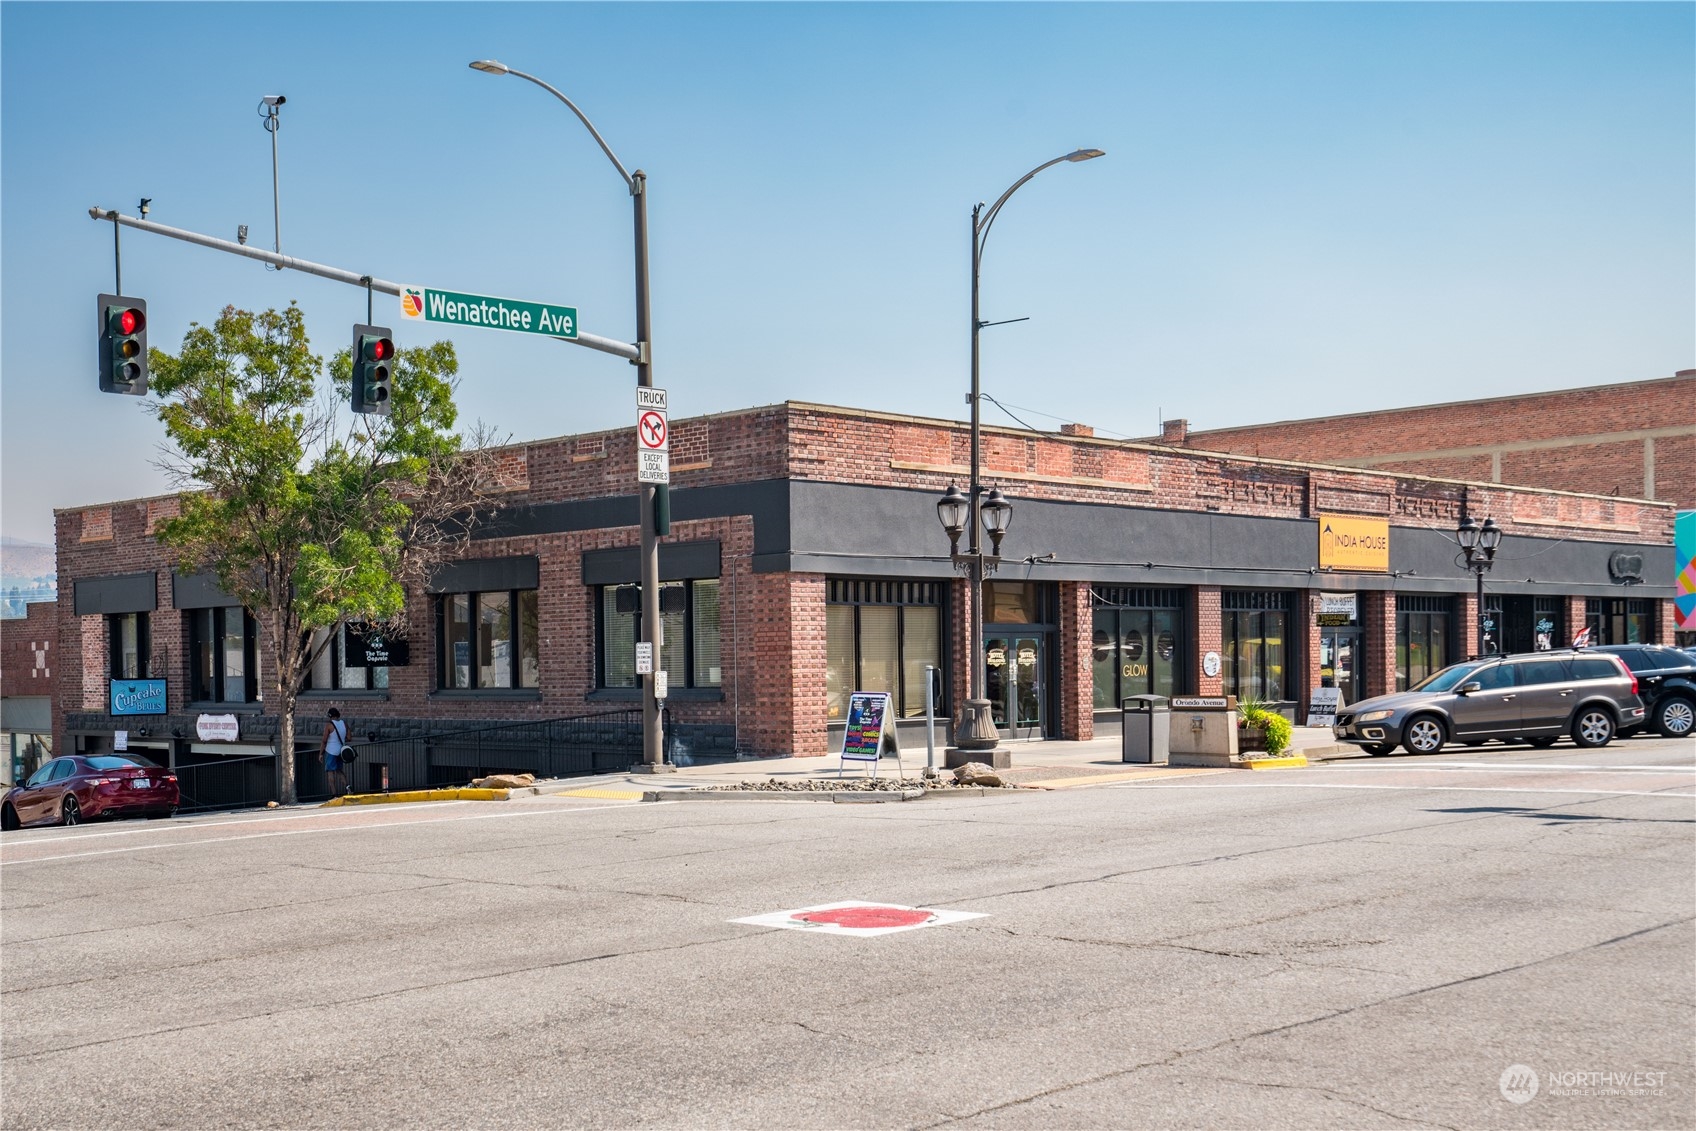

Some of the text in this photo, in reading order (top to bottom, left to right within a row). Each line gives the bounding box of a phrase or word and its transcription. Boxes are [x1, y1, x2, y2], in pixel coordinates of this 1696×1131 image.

[429, 293, 573, 334] Wenatchee Ave
[639, 391, 665, 405] TRUCK
[643, 453, 663, 463] EXCEPT
[645, 462, 662, 471] LOCAL
[640, 470, 668, 481] DELIVERIES
[1335, 534, 1386, 550] INDIA HOUSE
[1123, 664, 1148, 677] GLOW
[115, 684, 162, 711] Cupcake
